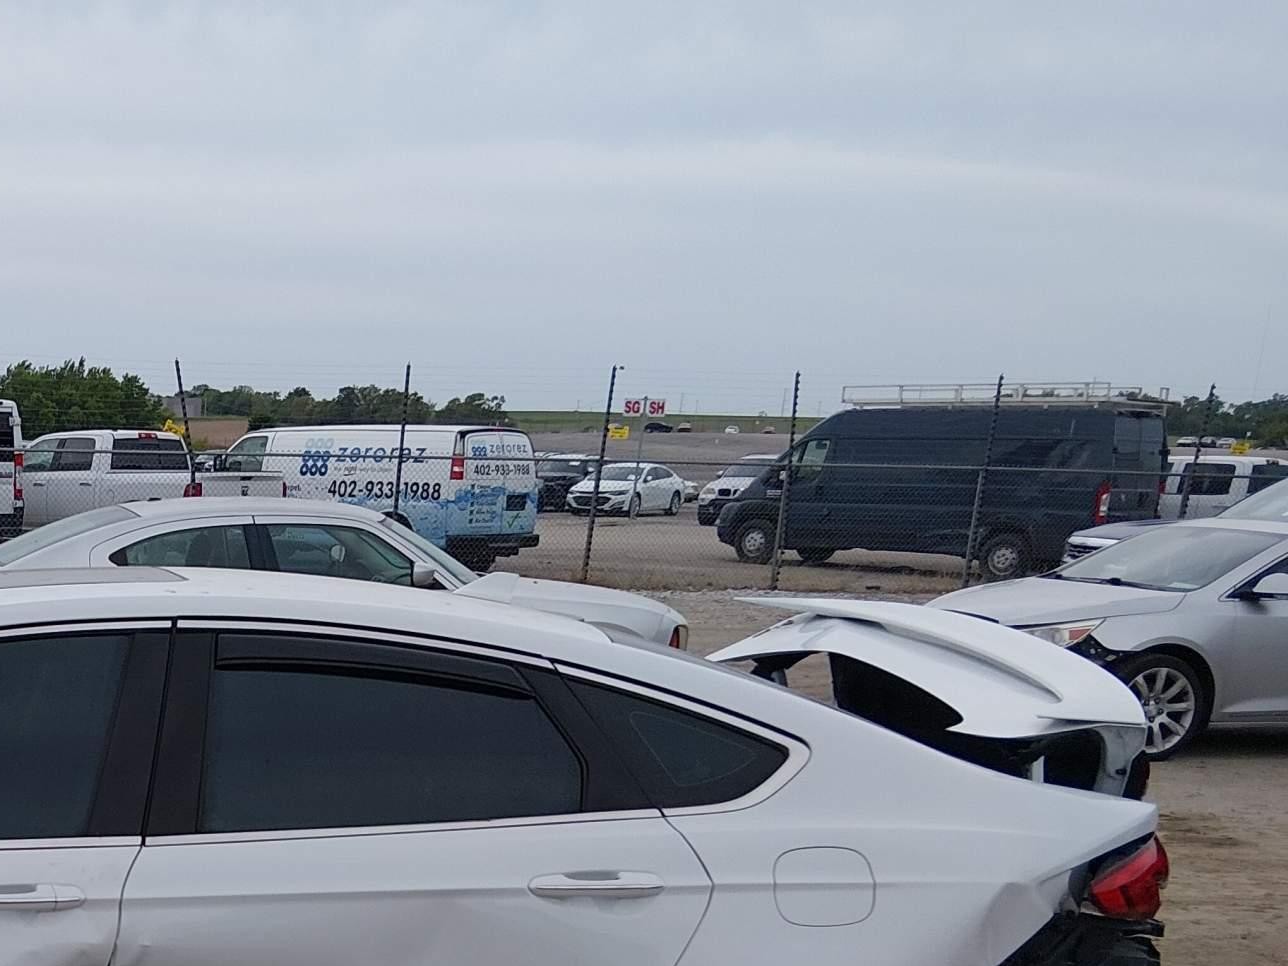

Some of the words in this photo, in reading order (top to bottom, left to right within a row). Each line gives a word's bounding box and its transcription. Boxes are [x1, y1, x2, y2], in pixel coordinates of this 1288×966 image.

[624, 400, 641, 414] SG
[648, 401, 665, 415] SH
[489, 443, 528, 454] zerorez
[473, 464, 530, 476] 402-933-1988
[327, 480, 442, 501] 402-933-1988
